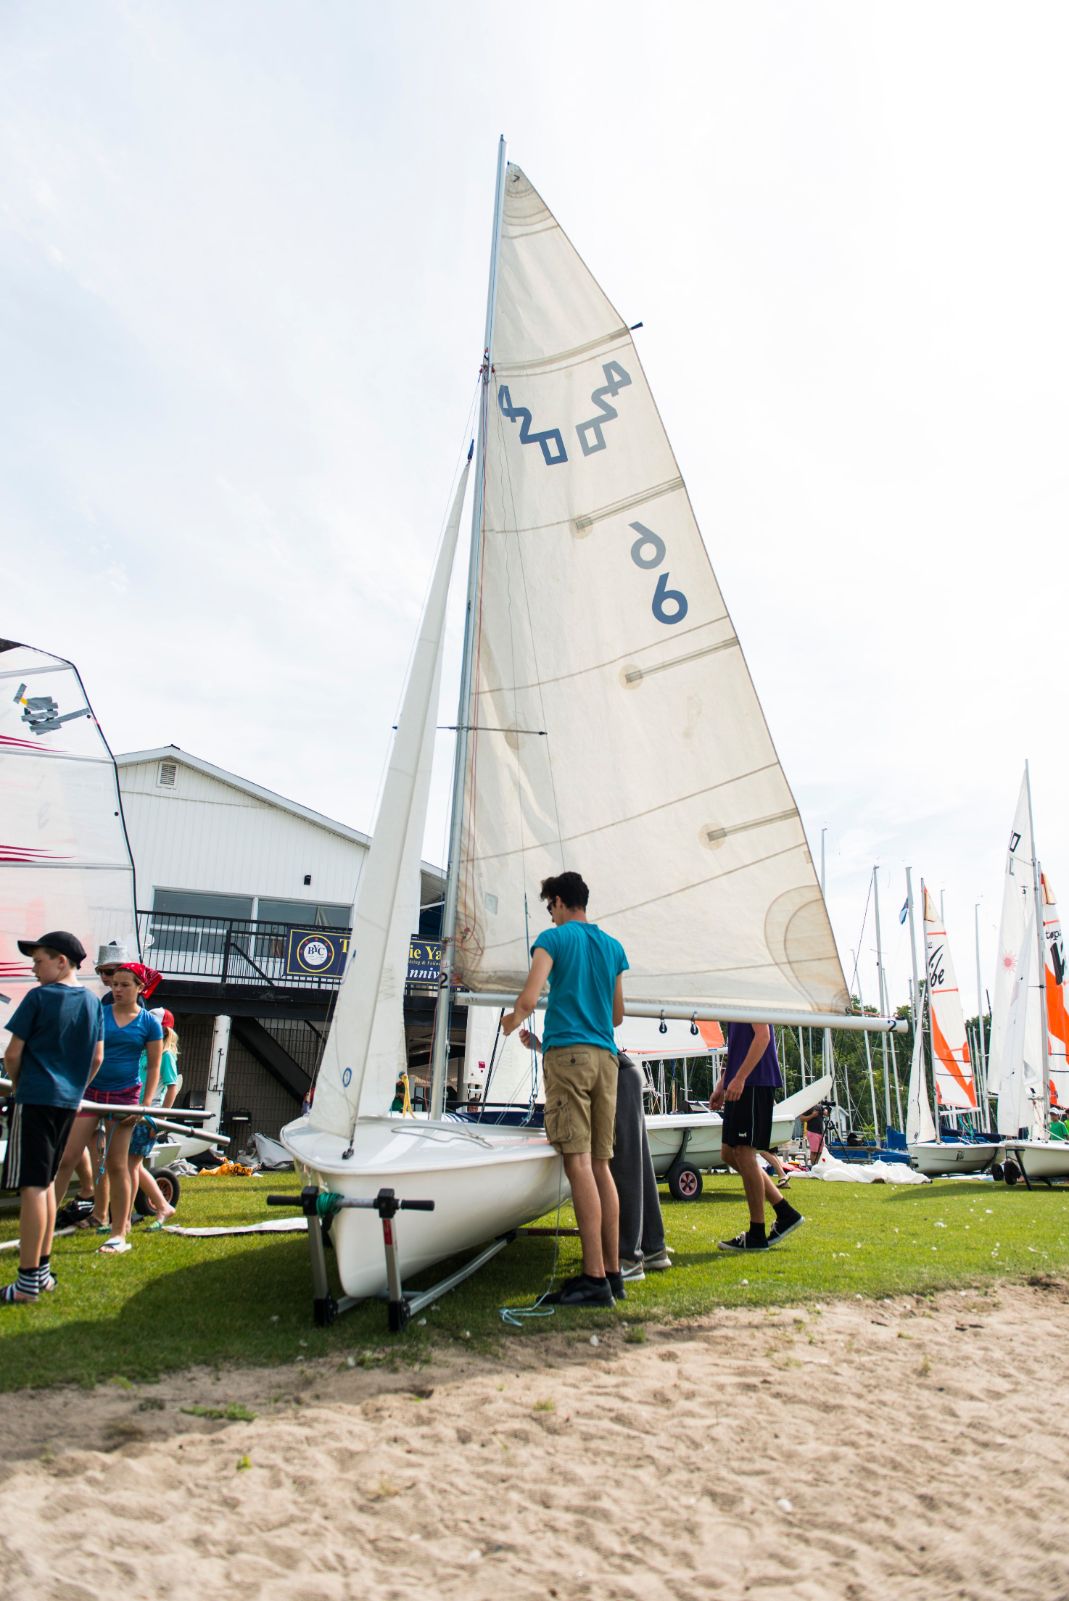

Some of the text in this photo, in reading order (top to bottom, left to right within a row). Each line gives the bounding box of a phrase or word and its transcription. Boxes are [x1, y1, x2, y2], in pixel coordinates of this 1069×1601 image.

[497, 384, 569, 466] 420
[651, 571, 689, 625] 6
[425, 946, 442, 960] Ya
[410, 967, 440, 979] nniv
